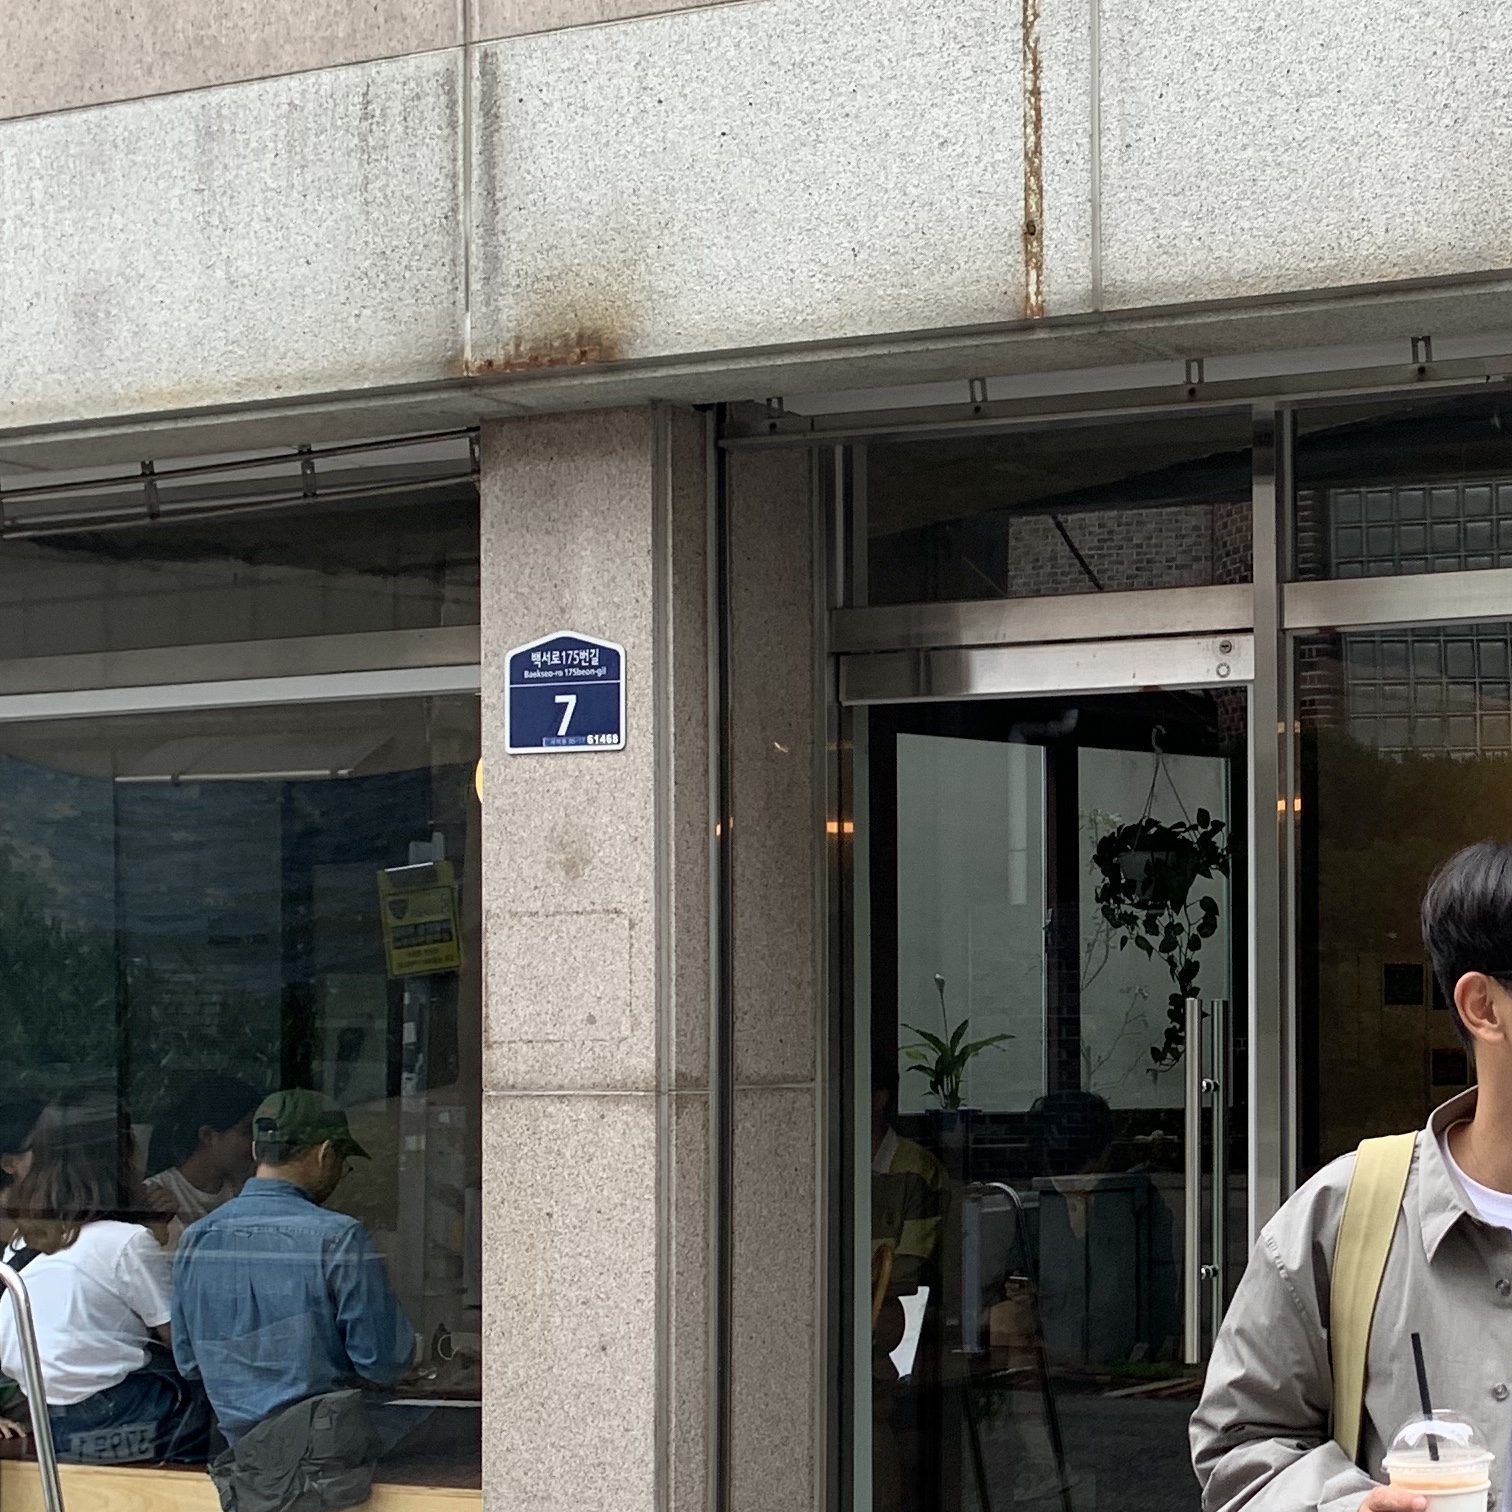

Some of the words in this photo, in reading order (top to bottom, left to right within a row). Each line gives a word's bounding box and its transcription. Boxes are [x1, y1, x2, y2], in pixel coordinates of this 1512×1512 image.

[531, 648, 599, 668] 백서로175번길
[554, 694, 577, 736] 7
[586, 733, 619, 745] 61468
